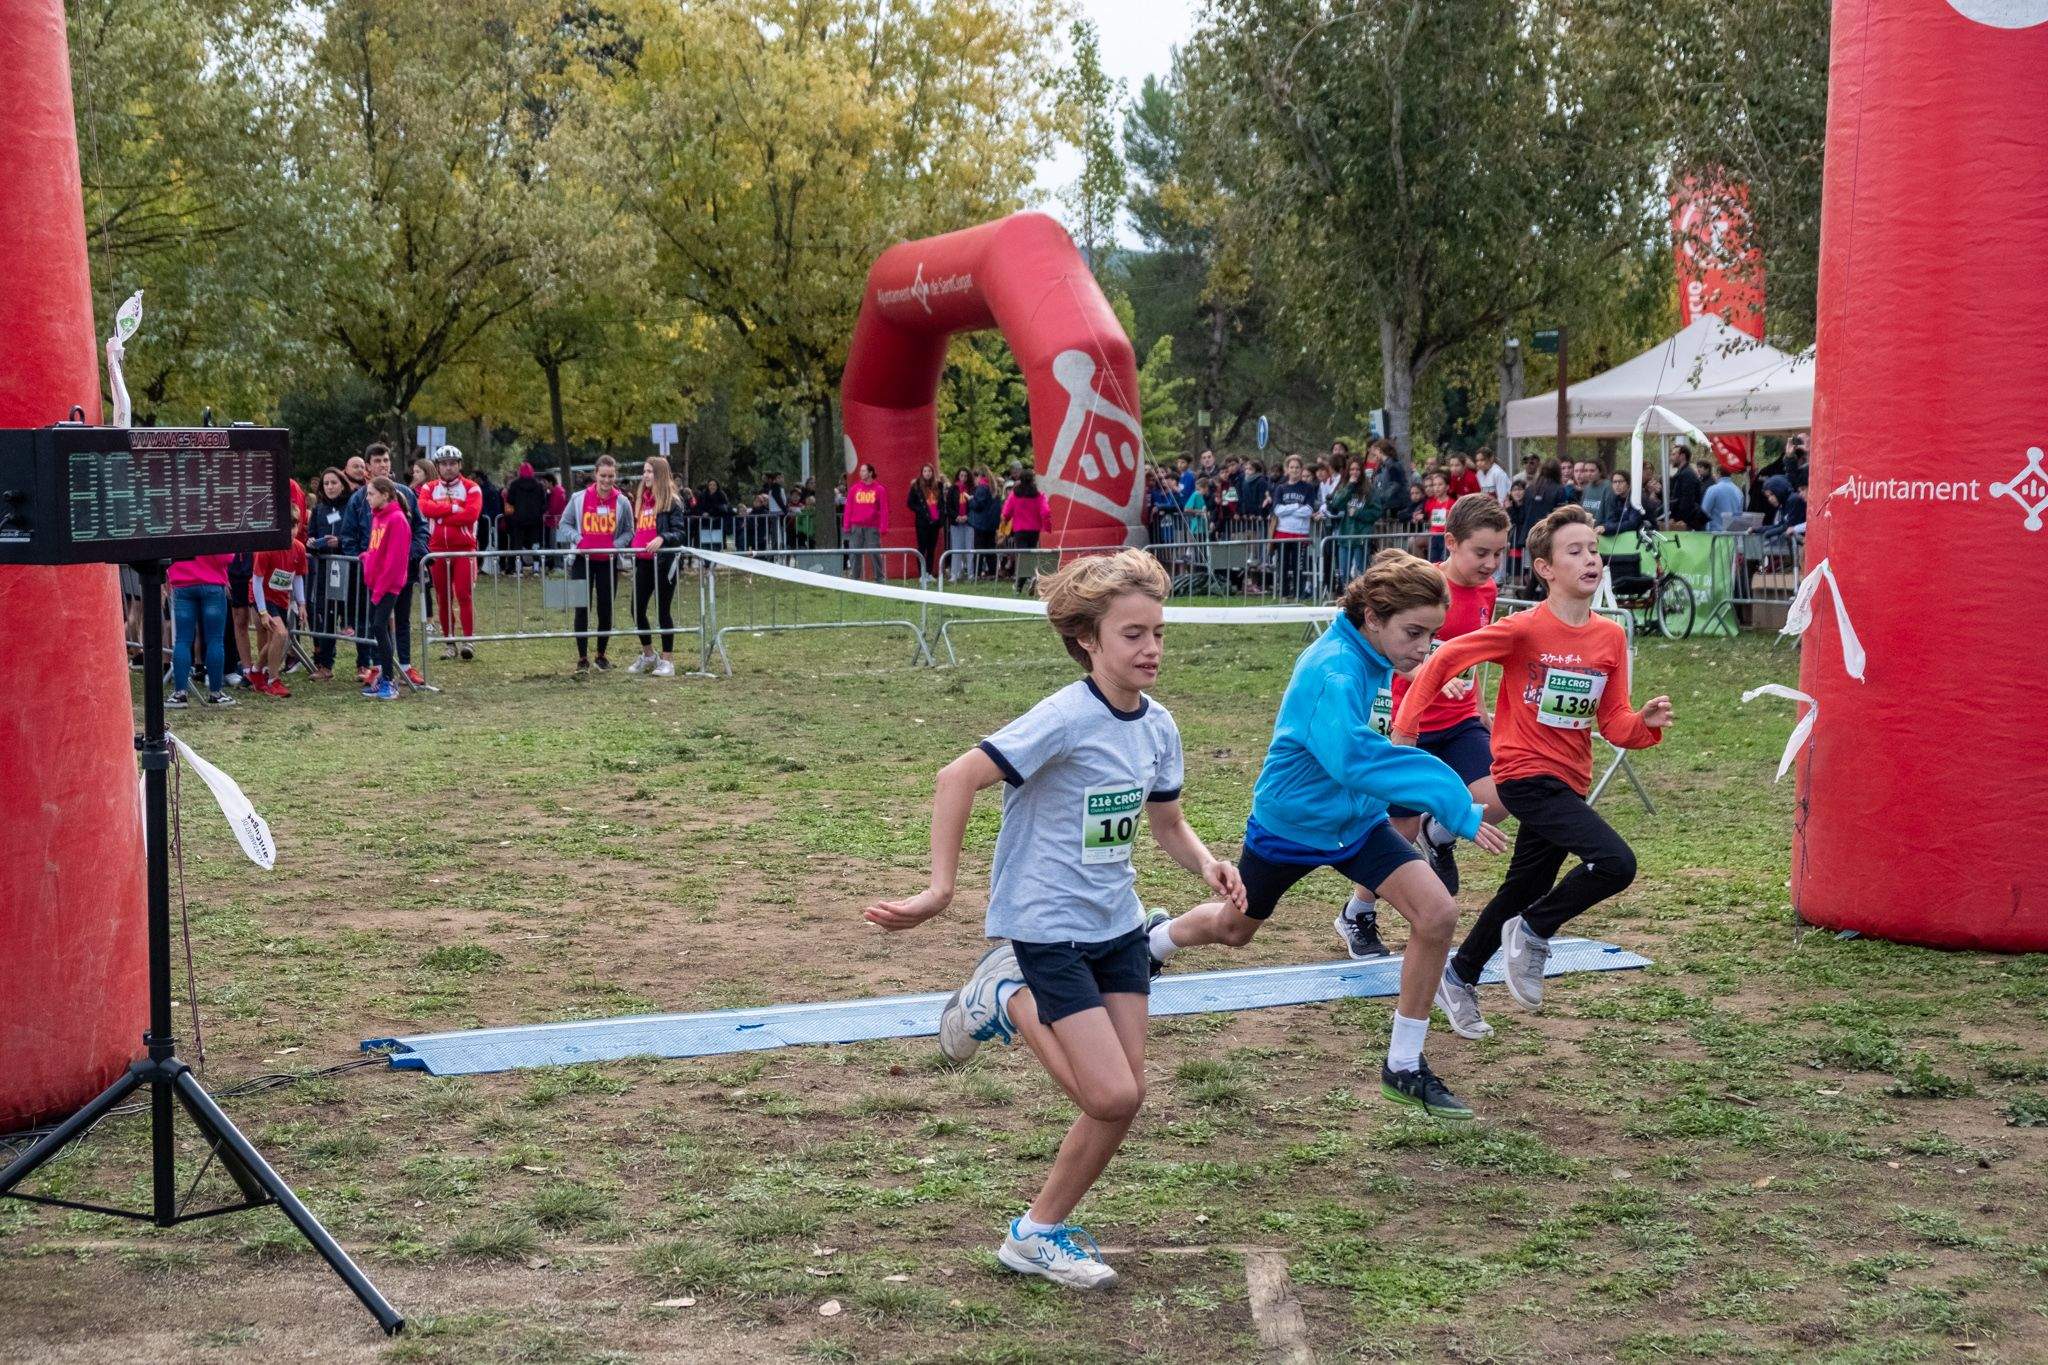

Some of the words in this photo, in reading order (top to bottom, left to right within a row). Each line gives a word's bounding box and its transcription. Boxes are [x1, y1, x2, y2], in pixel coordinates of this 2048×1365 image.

[130, 431, 230, 449] WWW.MACSHA.COM
[856, 491, 876, 504] CROS
[1845, 474, 1980, 505] Ajuntament
[583, 511, 617, 532] CROS
[1568, 680, 1590, 688] CROS
[1091, 796, 1111, 807] 21è
[1114, 791, 1141, 805] CROS
